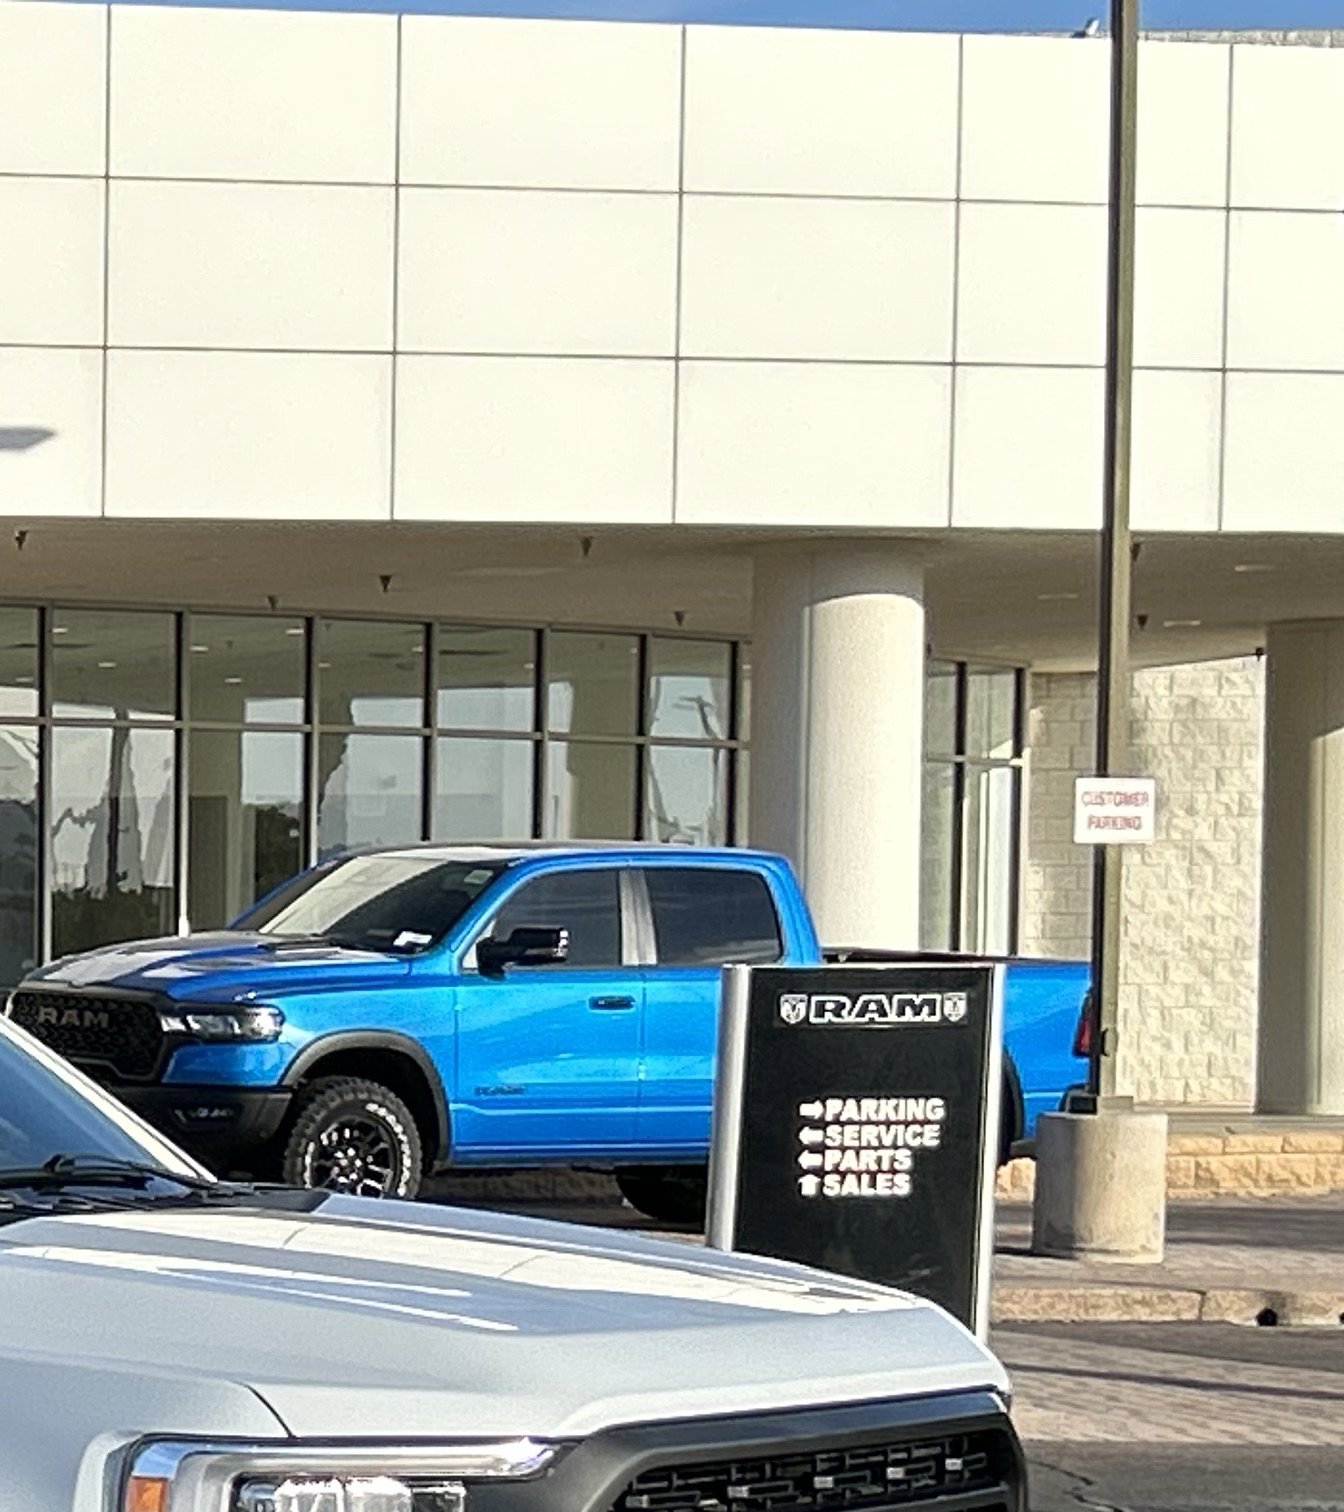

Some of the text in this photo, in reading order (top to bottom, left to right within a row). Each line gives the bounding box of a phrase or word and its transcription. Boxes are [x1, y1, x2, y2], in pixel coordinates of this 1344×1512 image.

[37, 1006, 109, 1027] RAM
[810, 995, 942, 1023] RAM
[824, 1098, 945, 1122] PARKING
[824, 1124, 940, 1147] SERVICE
[824, 1149, 911, 1172] PARTS
[822, 1173, 910, 1197] SALES
